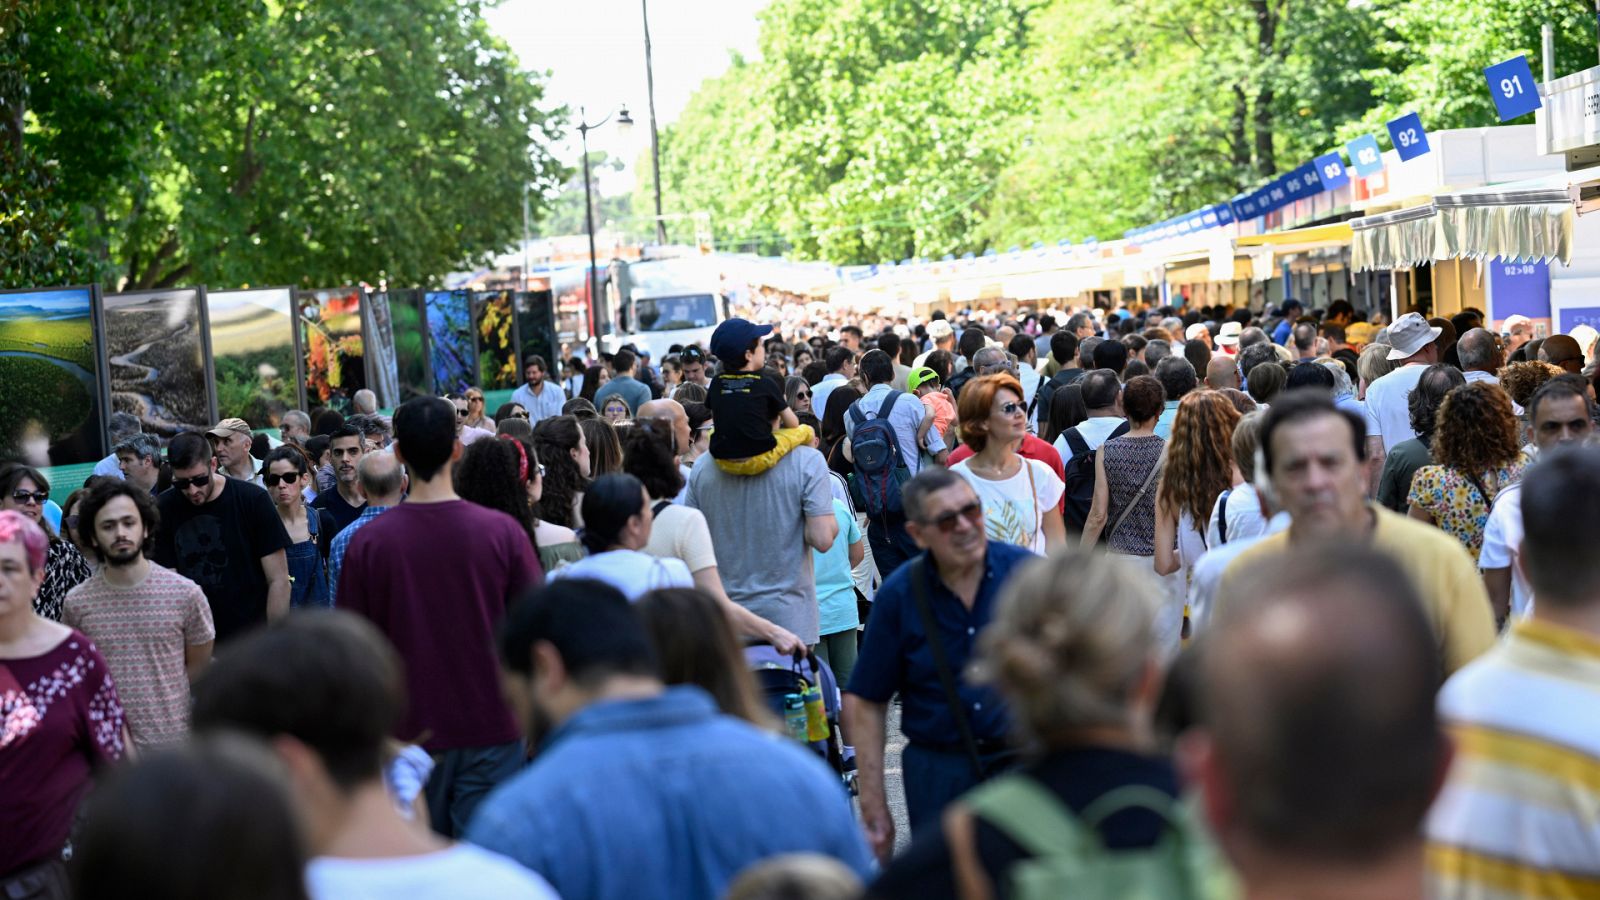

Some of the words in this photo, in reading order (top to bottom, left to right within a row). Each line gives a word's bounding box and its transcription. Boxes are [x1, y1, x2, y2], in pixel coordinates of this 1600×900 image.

[1501, 75, 1523, 98] 91
[1398, 128, 1419, 147] 92
[1304, 171, 1319, 186] 94
[1324, 162, 1341, 179] 93
